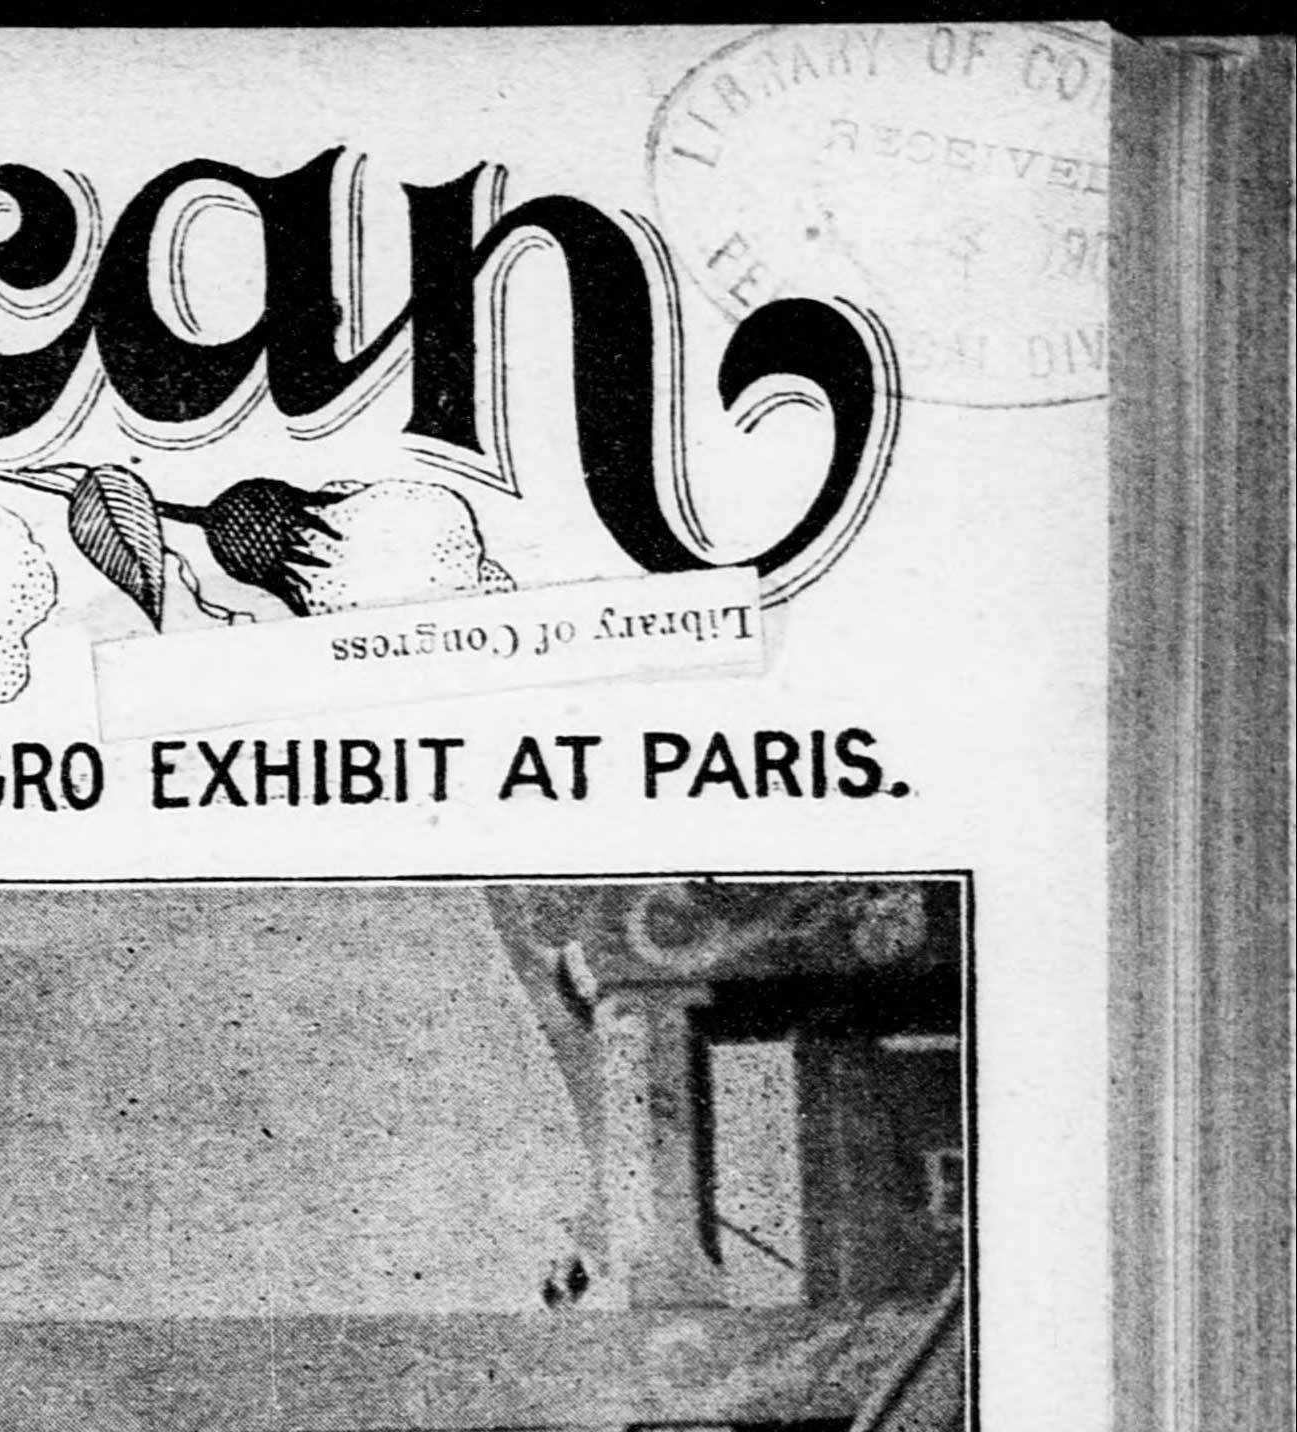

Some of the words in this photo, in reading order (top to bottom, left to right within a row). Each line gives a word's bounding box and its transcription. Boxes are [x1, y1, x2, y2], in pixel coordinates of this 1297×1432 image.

[927, 26, 996, 77] OF
[331, 622, 521, 661] Congress
[534, 620, 577, 656] of
[594, 605, 754, 642] Library
[151, 737, 466, 810] EXHIBIT
[498, 735, 603, 801] AT
[643, 727, 911, 800] PARIS.
